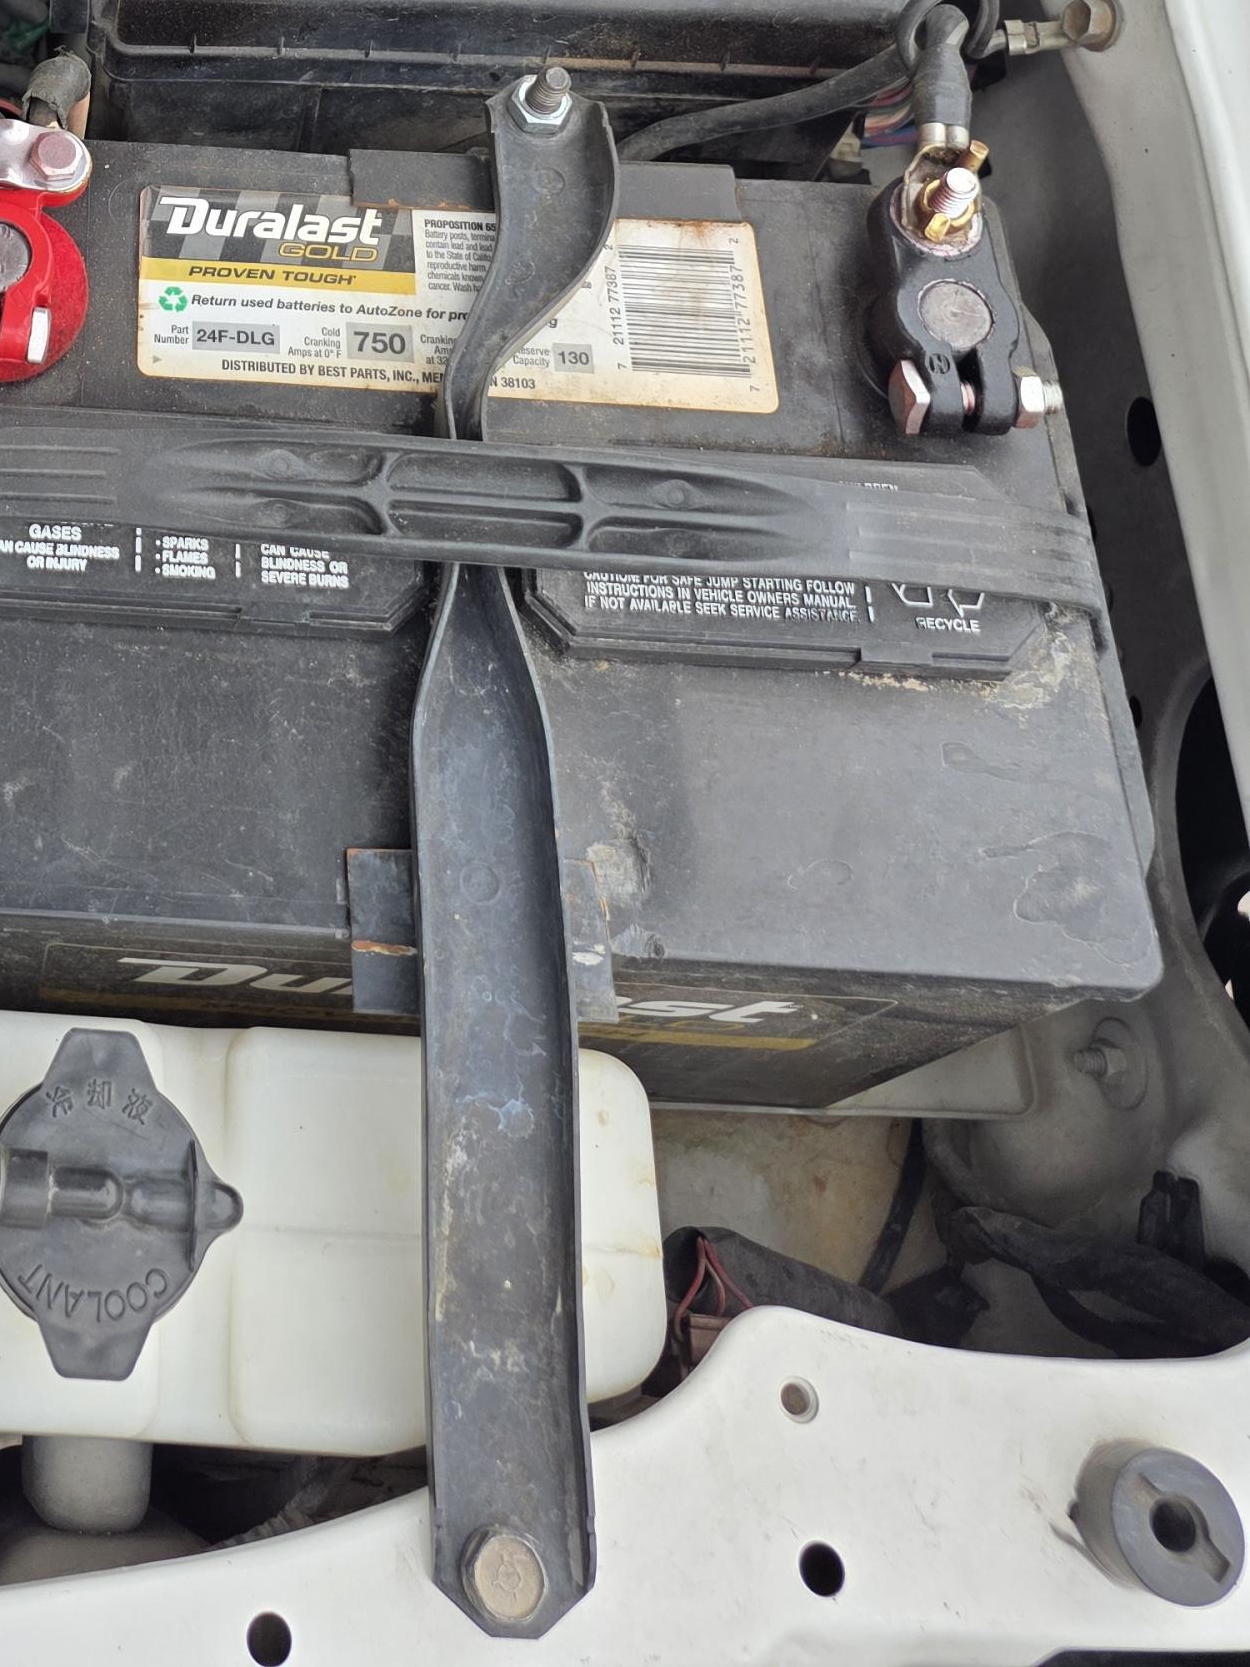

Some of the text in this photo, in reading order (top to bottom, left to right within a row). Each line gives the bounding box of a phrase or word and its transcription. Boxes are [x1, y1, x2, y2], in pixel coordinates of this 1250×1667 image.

[159, 196, 383, 245] Duralast
[424, 219, 483, 231] PROPOSITION
[278, 242, 379, 262] GOLD
[188, 265, 276, 280] PROVEN
[191, 294, 446, 320] Return used batteries to AutoZone for
[604, 266, 624, 346] 21112 77387
[171, 325, 189, 335] Part
[196, 328, 276, 347] 24F-DLG
[321, 327, 341, 338] Cold
[154, 334, 189, 345] Number
[303, 337, 341, 350] Cranking
[353, 330, 407, 355] 750
[287, 347, 324, 359] Amps at
[558, 350, 590, 365] 130
[512, 355, 550, 367] Capacity
[221, 358, 420, 384] DISTRIBUTED BY BEST PARTS, INC.,
[501, 377, 536, 389] 38103
[28, 524, 82, 541] GASES
[15, 541, 54, 555] CAUSE
[162, 536, 209, 551] SPARKS
[260, 543, 286, 556] CAN
[27, 556, 88, 572] OR INJURY
[162, 550, 208, 565] FLAMES
[261, 556, 348, 574] BLINDNESS OR
[162, 564, 216, 579] SMOKING
[261, 570, 350, 589] SEVERE BURNS
[706, 576, 739, 588] JUMP
[742, 577, 803, 591] STARTING
[806, 580, 855, 595] FOLLOW
[586, 581, 674, 599] INSTRUCTIONS
[677, 587, 690, 600] IN
[693, 588, 744, 603] VEHICLE
[747, 590, 799, 605] OWNERS
[584, 595, 596, 608] IF
[600, 596, 625, 610] NOT
[630, 598, 692, 614] AVAILABLE
[695, 602, 727, 615] SEEK
[730, 603, 780, 619] SERVICE
[915, 617, 981, 632] RECYCLE
[46, 1078, 153, 1126] 冷却液
[17, 1263, 168, 1323] COOLANT
